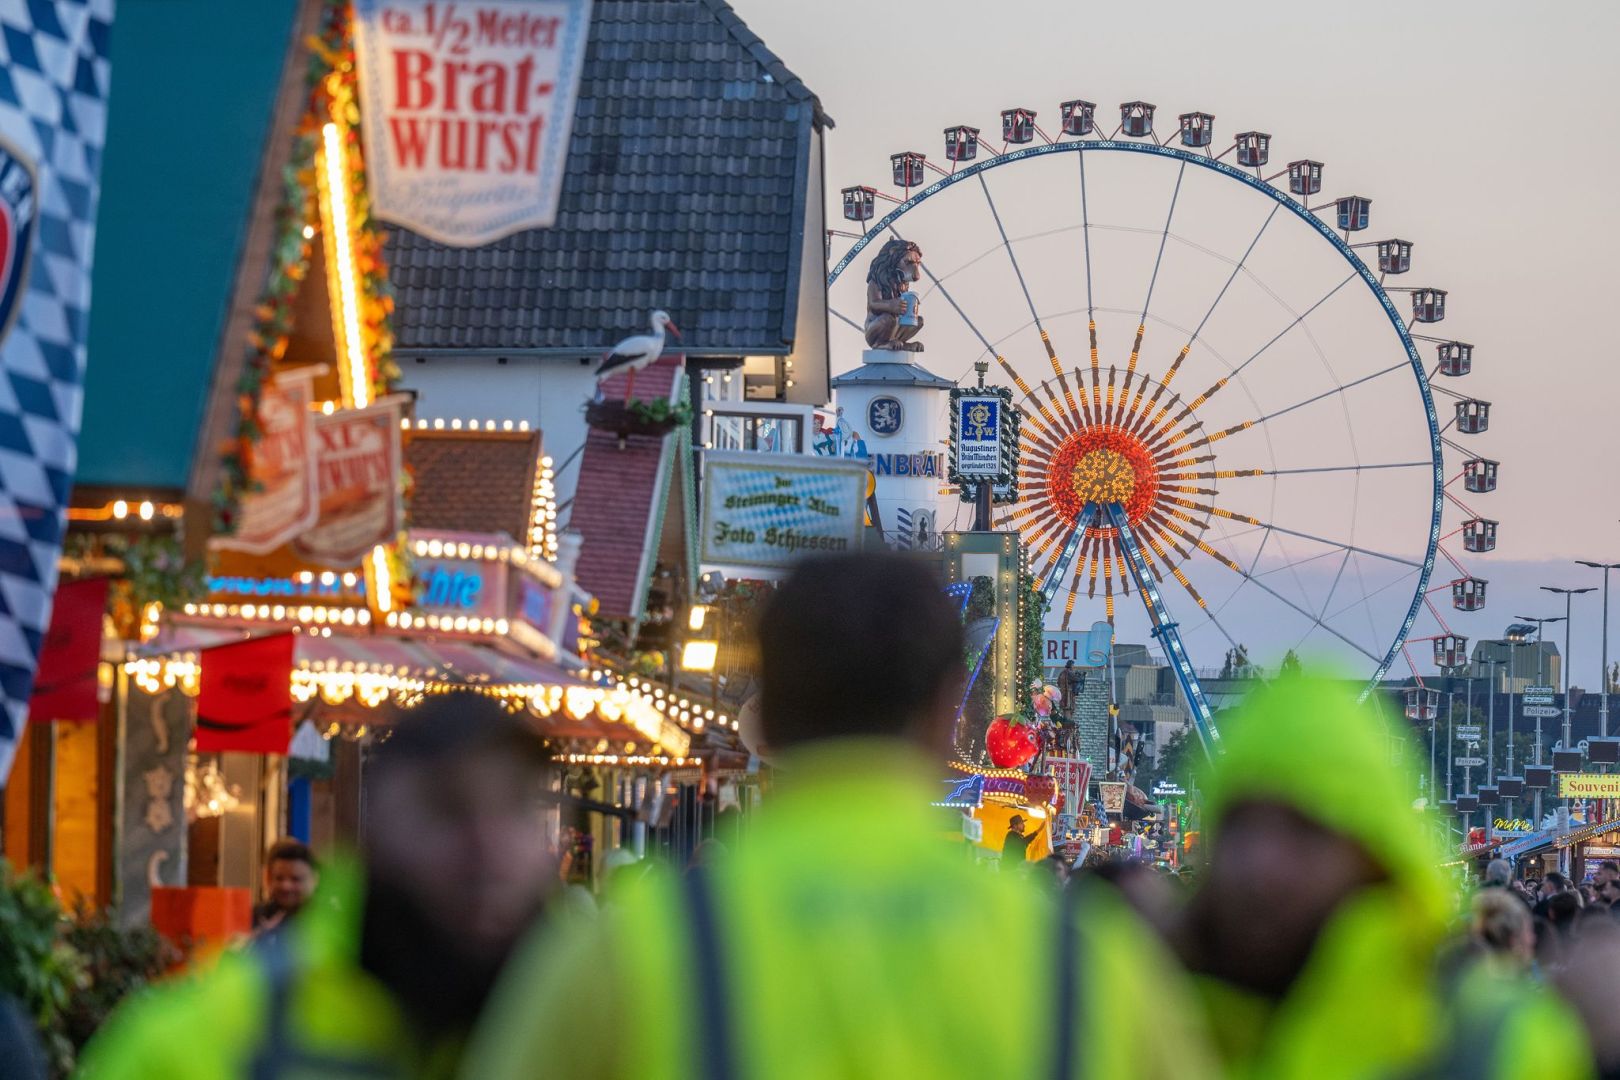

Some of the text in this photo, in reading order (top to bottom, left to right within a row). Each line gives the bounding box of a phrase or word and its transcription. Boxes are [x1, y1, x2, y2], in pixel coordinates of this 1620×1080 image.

[475, 9, 562, 50] Meter
[393, 48, 554, 115] Brat-
[867, 450, 944, 479] NBRÄ
[713, 520, 756, 546] Foto
[1047, 639, 1078, 660] REI
[1526, 706, 1551, 716] Polizei
[1568, 779, 1620, 793] Souveni
